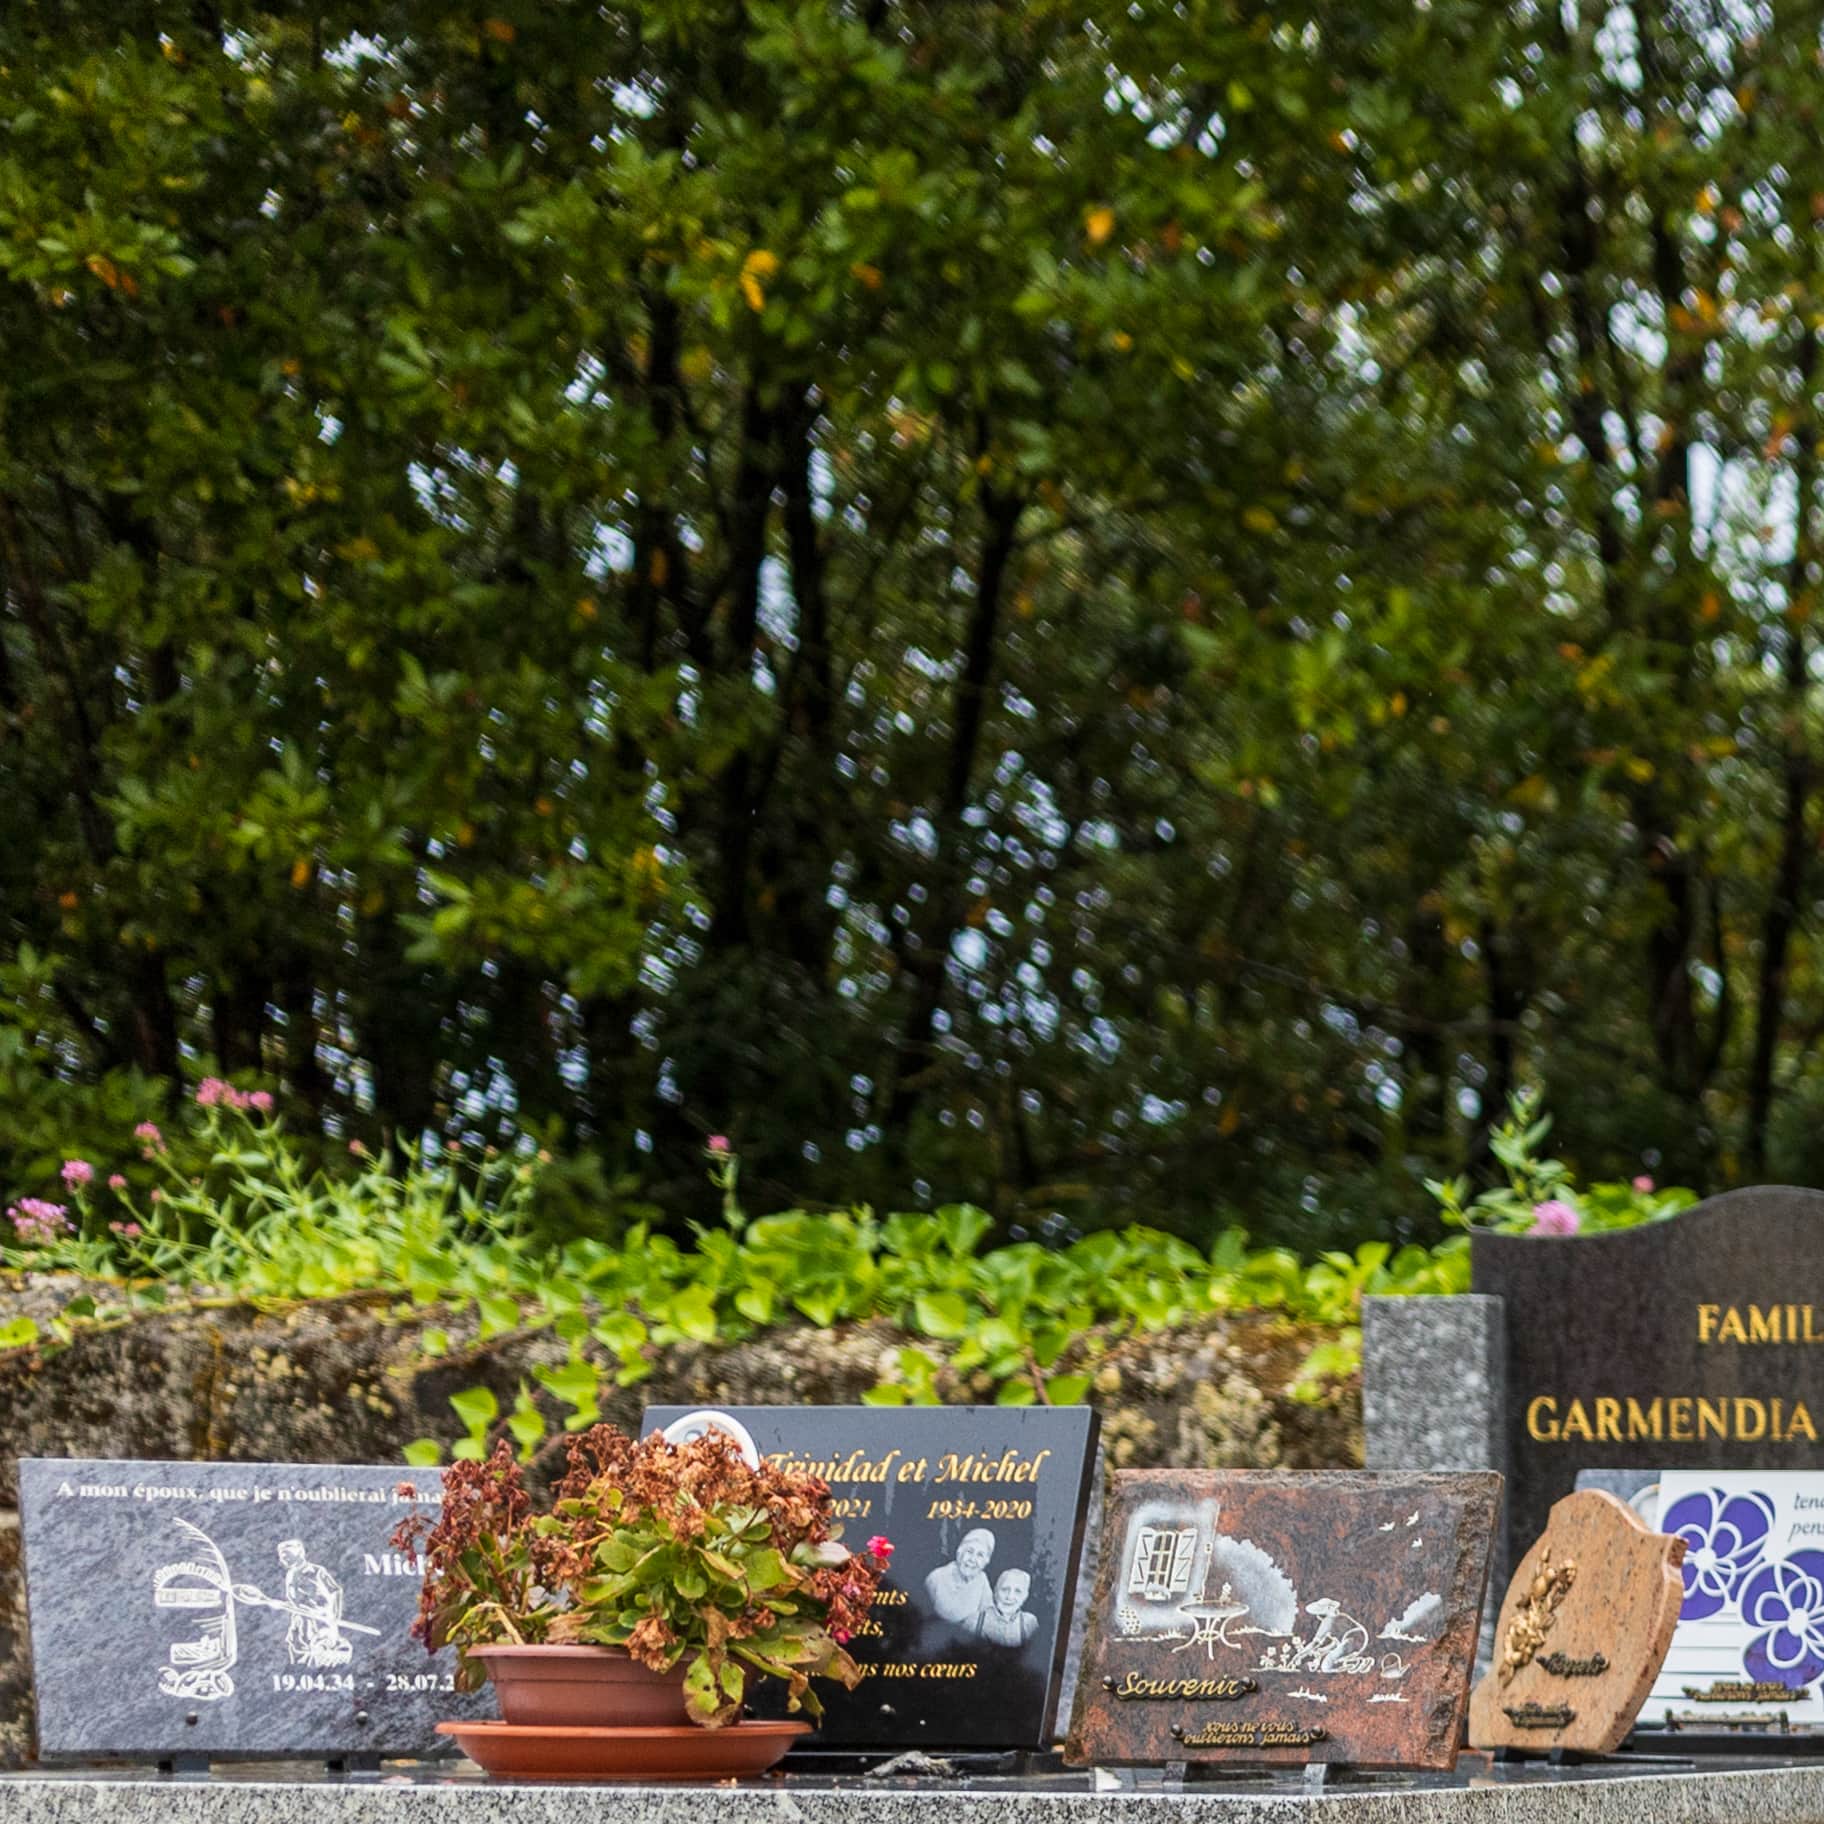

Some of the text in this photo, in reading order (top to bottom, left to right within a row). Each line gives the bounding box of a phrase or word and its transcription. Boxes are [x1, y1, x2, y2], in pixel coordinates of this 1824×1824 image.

[764, 1449, 1051, 1484] Trinidad et Michel
[56, 1483, 78, 1500] A
[80, 1485, 128, 1499] mon
[133, 1483, 203, 1502] époux,
[209, 1487, 247, 1503] que
[251, 1484, 270, 1503] je
[277, 1486, 386, 1503] n'oublierai
[926, 1499, 1033, 1520] 1934-2020
[883, 1662, 916, 1678] nos
[920, 1662, 978, 1679] cœurs
[272, 1674, 355, 1692] 19.04.34
[385, 1674, 455, 1692] 28.07.2
[1116, 1671, 1240, 1697] Souvenir
